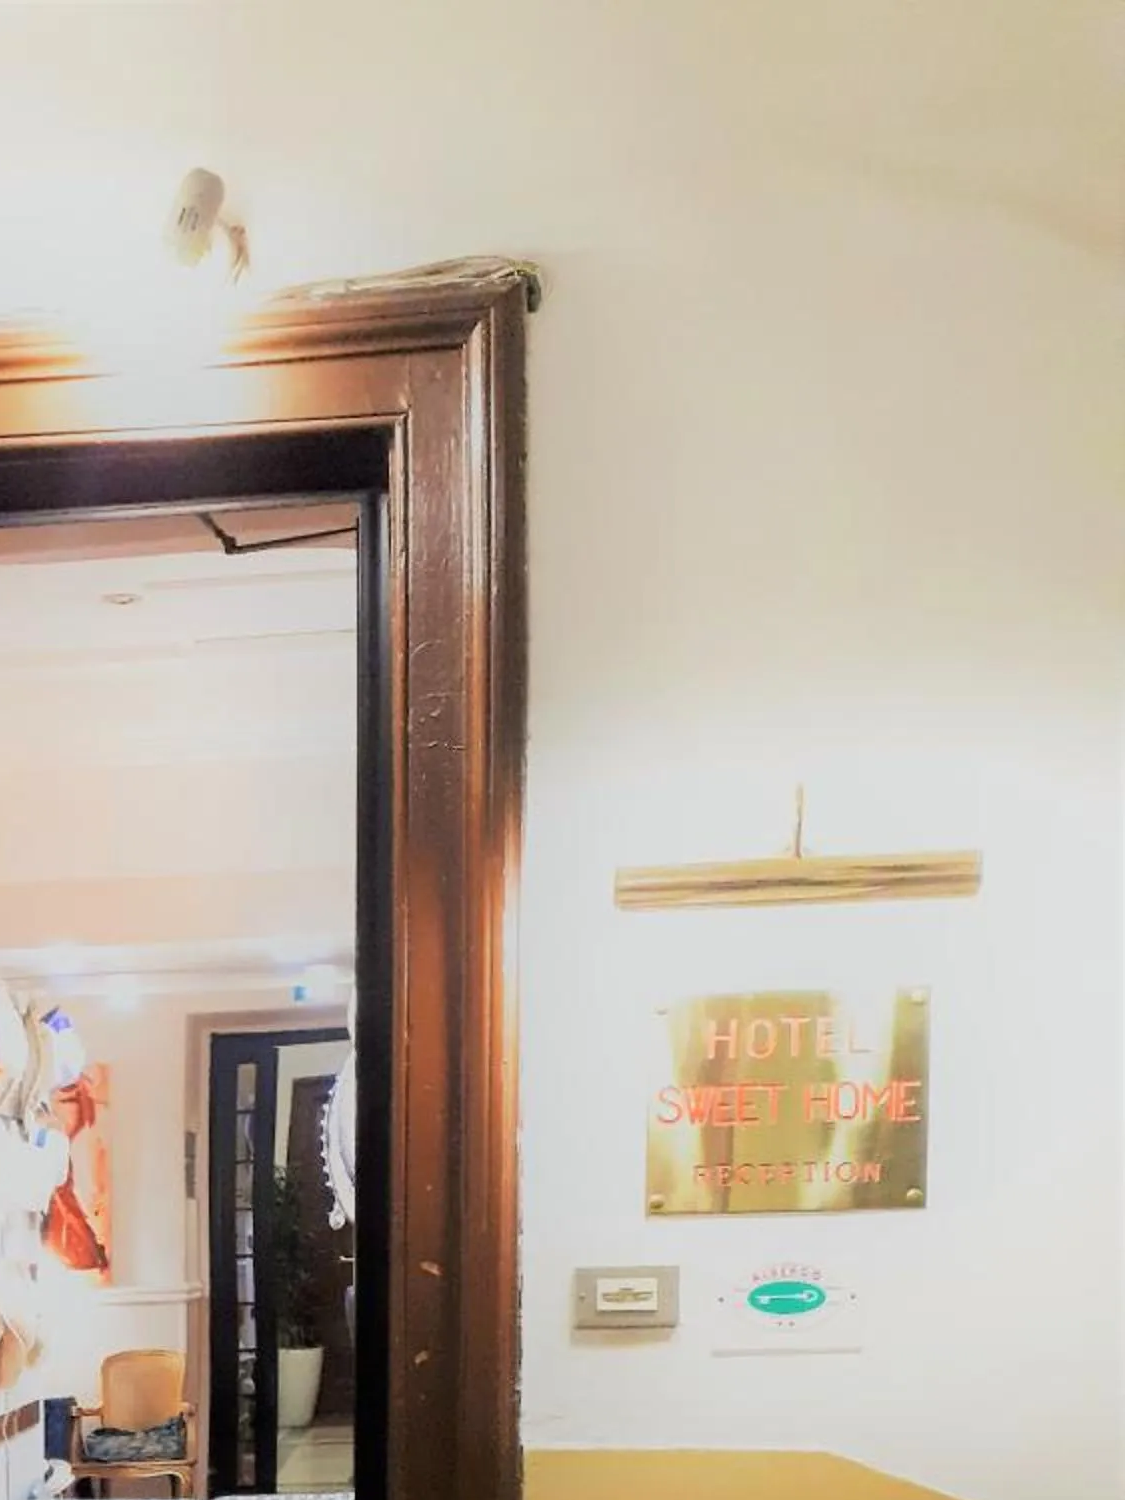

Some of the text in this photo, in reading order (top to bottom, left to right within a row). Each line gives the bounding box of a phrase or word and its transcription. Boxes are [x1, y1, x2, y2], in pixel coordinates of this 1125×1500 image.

[707, 1015, 873, 1060] HOTEL
[655, 1079, 923, 1128] SWEET HOME
[693, 1160, 885, 1187] RECEPTION
